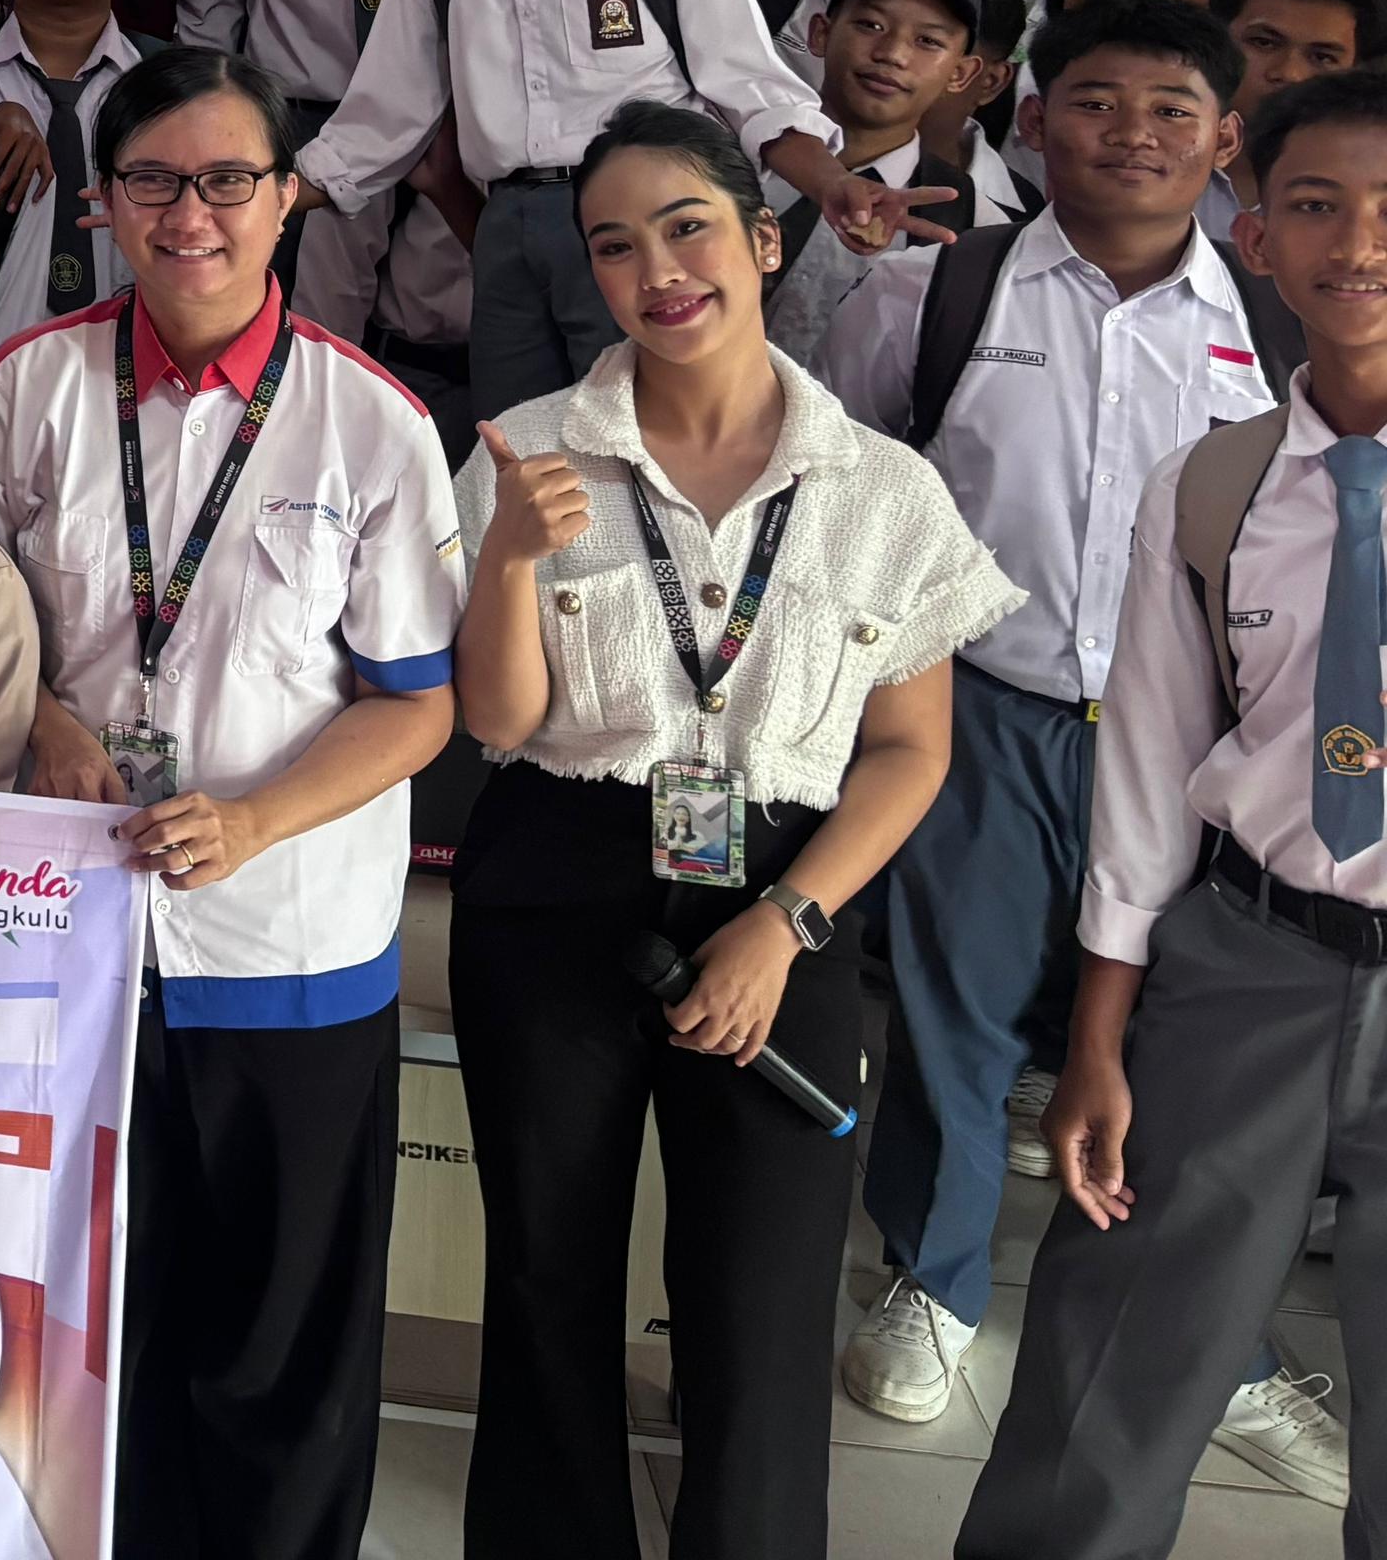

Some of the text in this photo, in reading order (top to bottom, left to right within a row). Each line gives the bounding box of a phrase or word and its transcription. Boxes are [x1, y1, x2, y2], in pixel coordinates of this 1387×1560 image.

[215, 461, 237, 505] astra motor
[288, 501, 318, 511] ASTRA
